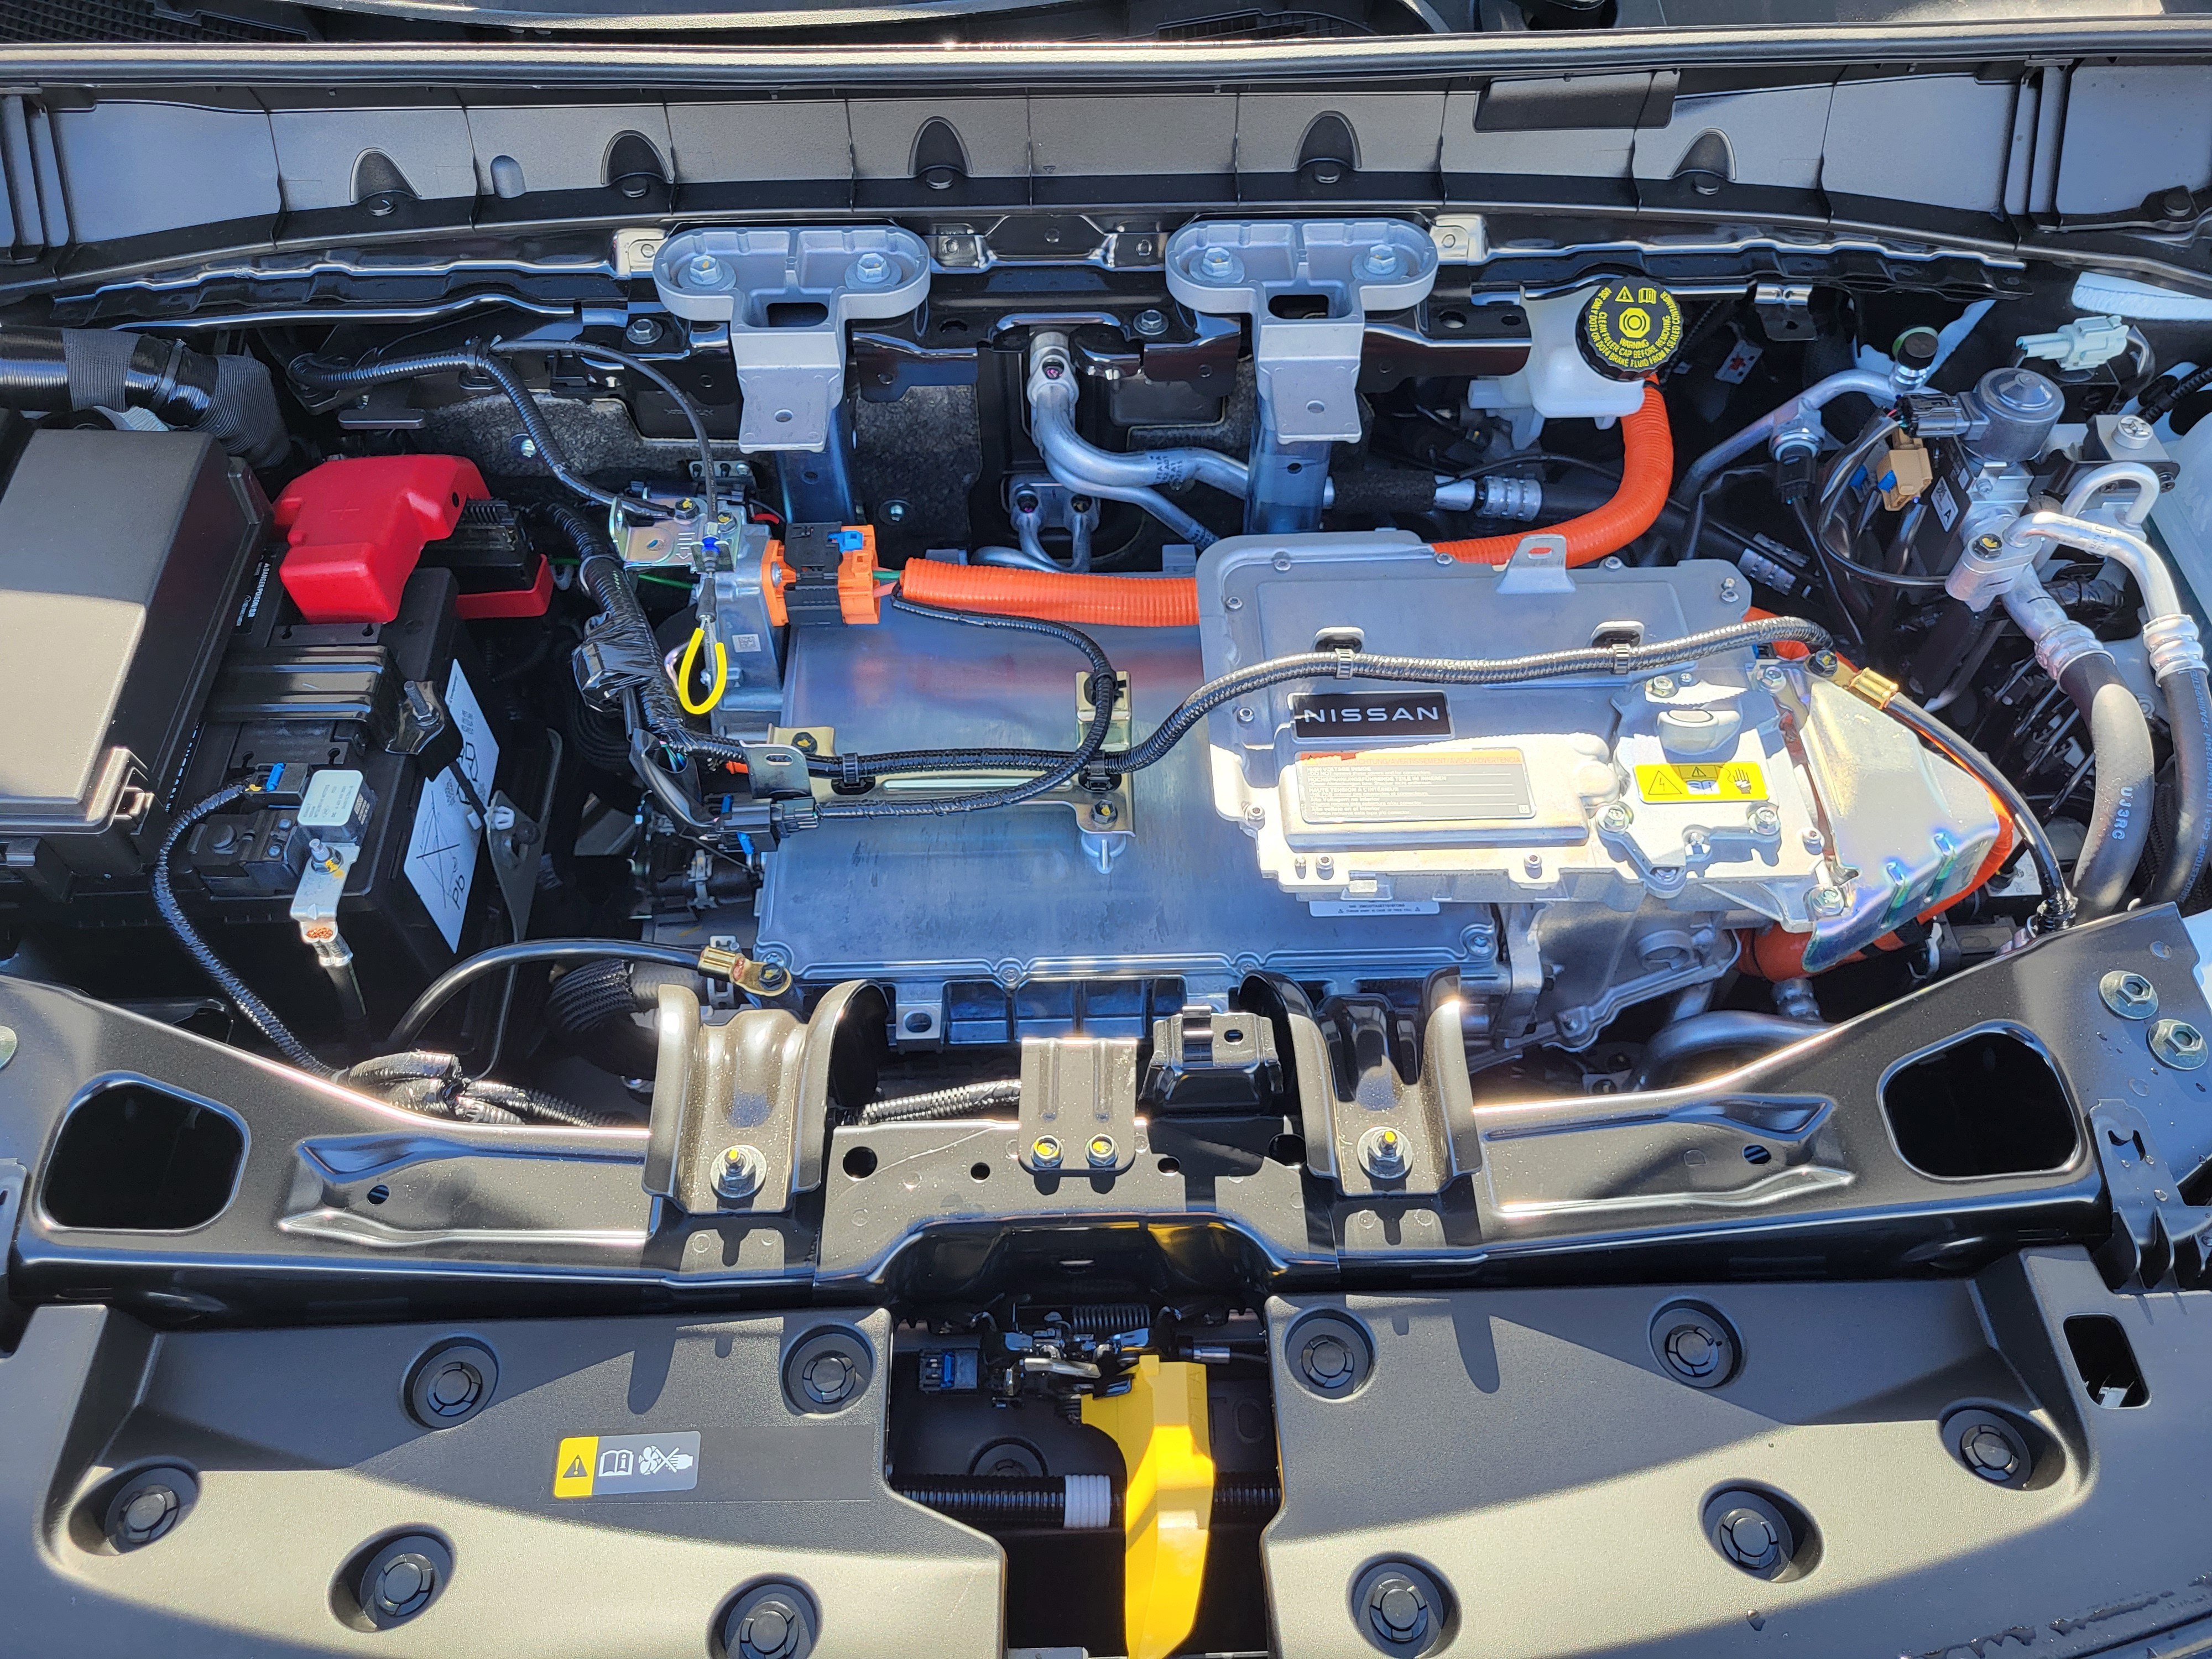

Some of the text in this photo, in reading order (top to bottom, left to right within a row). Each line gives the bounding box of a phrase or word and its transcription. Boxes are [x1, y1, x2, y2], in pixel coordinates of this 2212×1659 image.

[1598, 286, 1612, 300] USE
[1590, 298, 1603, 315] ONLY
[1590, 331, 1600, 342] OR
[1598, 311, 1672, 358] CLEAN FILLER CAP BEFORE REMOVING
[1666, 325, 1681, 349] SEALED
[1619, 337, 1650, 349] WARNING
[1608, 352, 1630, 367] BRAKE
[1630, 358, 1650, 368] FLUID
[1648, 350, 1667, 365] FROM
[1303, 706, 1439, 723] NISSAN
